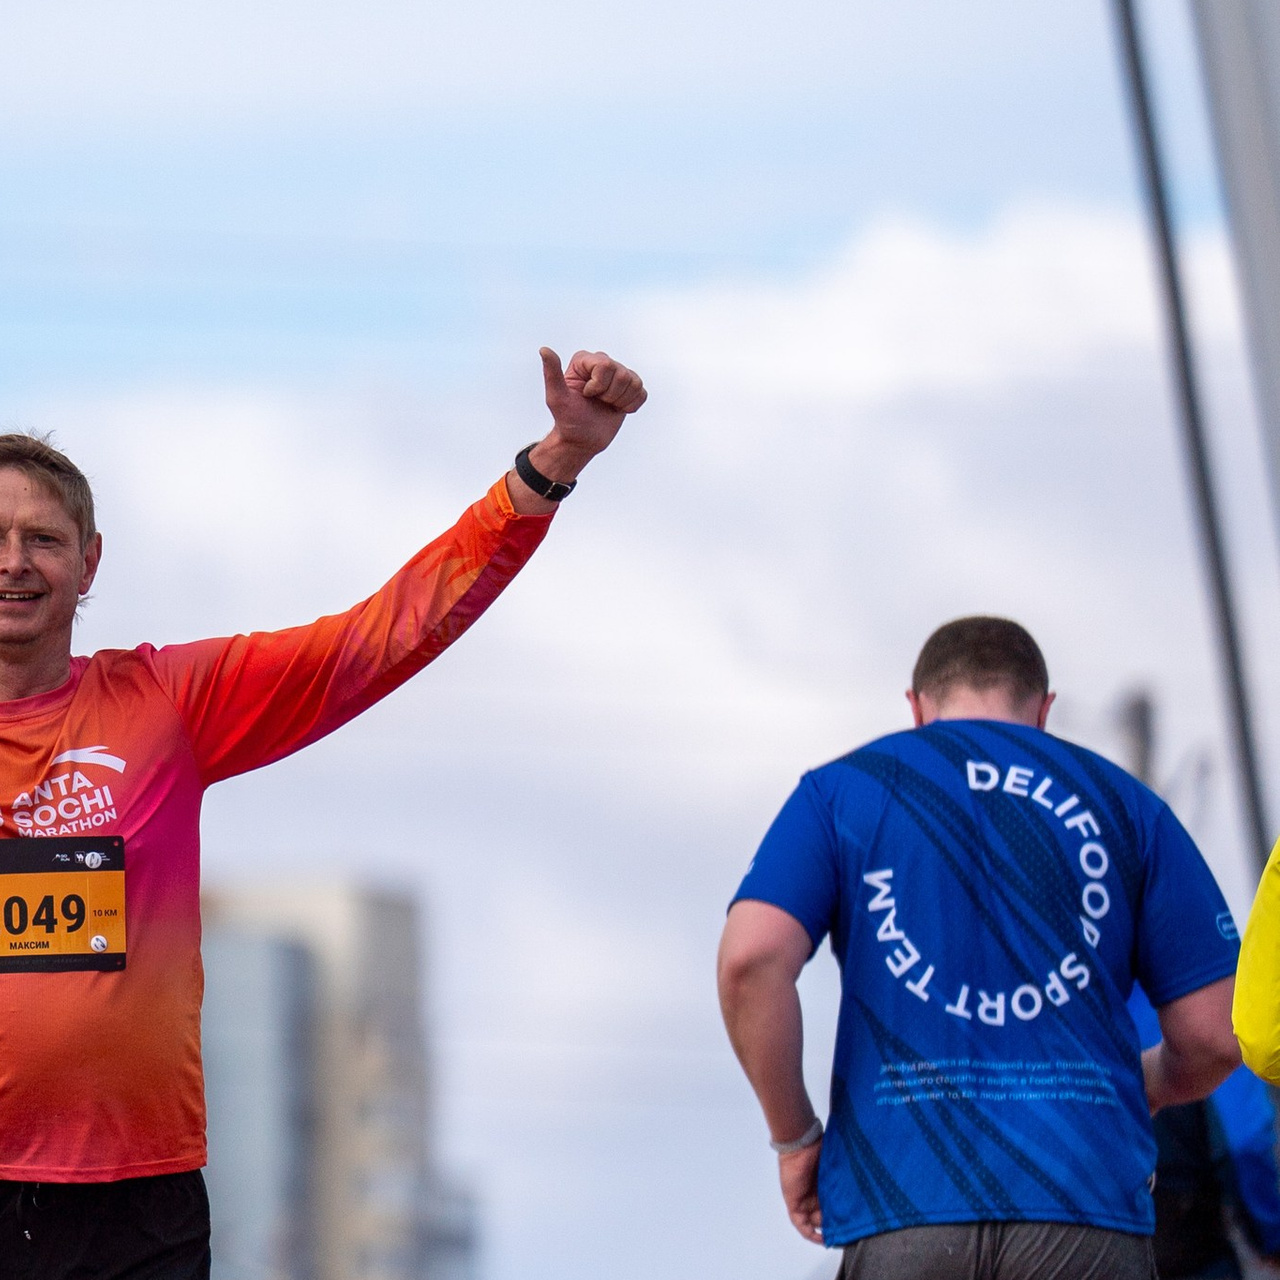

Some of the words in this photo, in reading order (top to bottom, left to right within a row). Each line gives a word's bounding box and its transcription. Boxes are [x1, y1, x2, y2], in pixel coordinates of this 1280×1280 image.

[11, 771, 94, 809] ANTA
[13, 785, 114, 828] SOCHI
[17, 807, 118, 838] MARATHON
[92, 909, 103, 917] 10
[9, 941, 50, 950] МАКСИМ
[863, 869, 935, 1002] TEAM
[946, 952, 1091, 1027] SPORT
